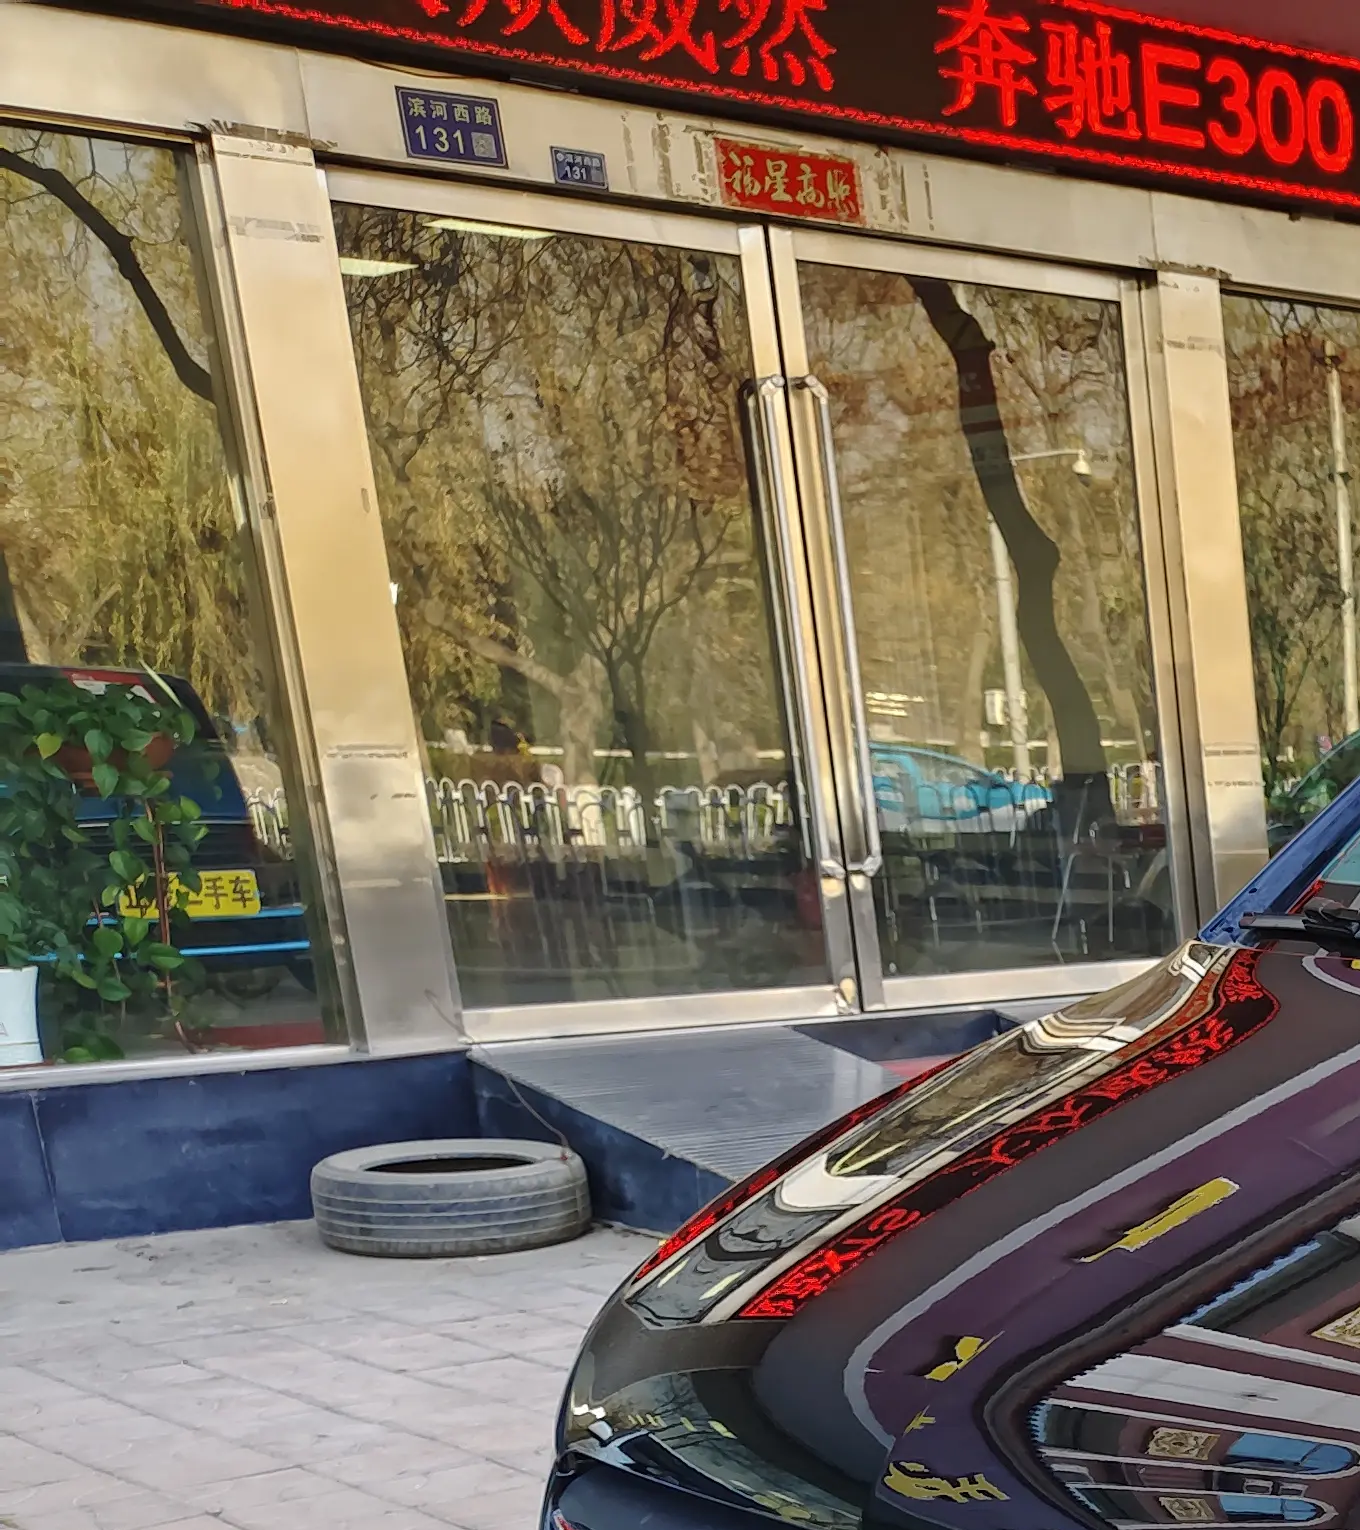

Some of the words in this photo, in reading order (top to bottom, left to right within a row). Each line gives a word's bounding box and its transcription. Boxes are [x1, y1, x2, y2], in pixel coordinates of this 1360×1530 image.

[935, 0, 1354, 172] 奔驰E300
[407, 97, 493, 126] 滨河西路
[414, 124, 465, 155] 131
[564, 165, 587, 181] 131
[724, 151, 857, 216] 福星高照
